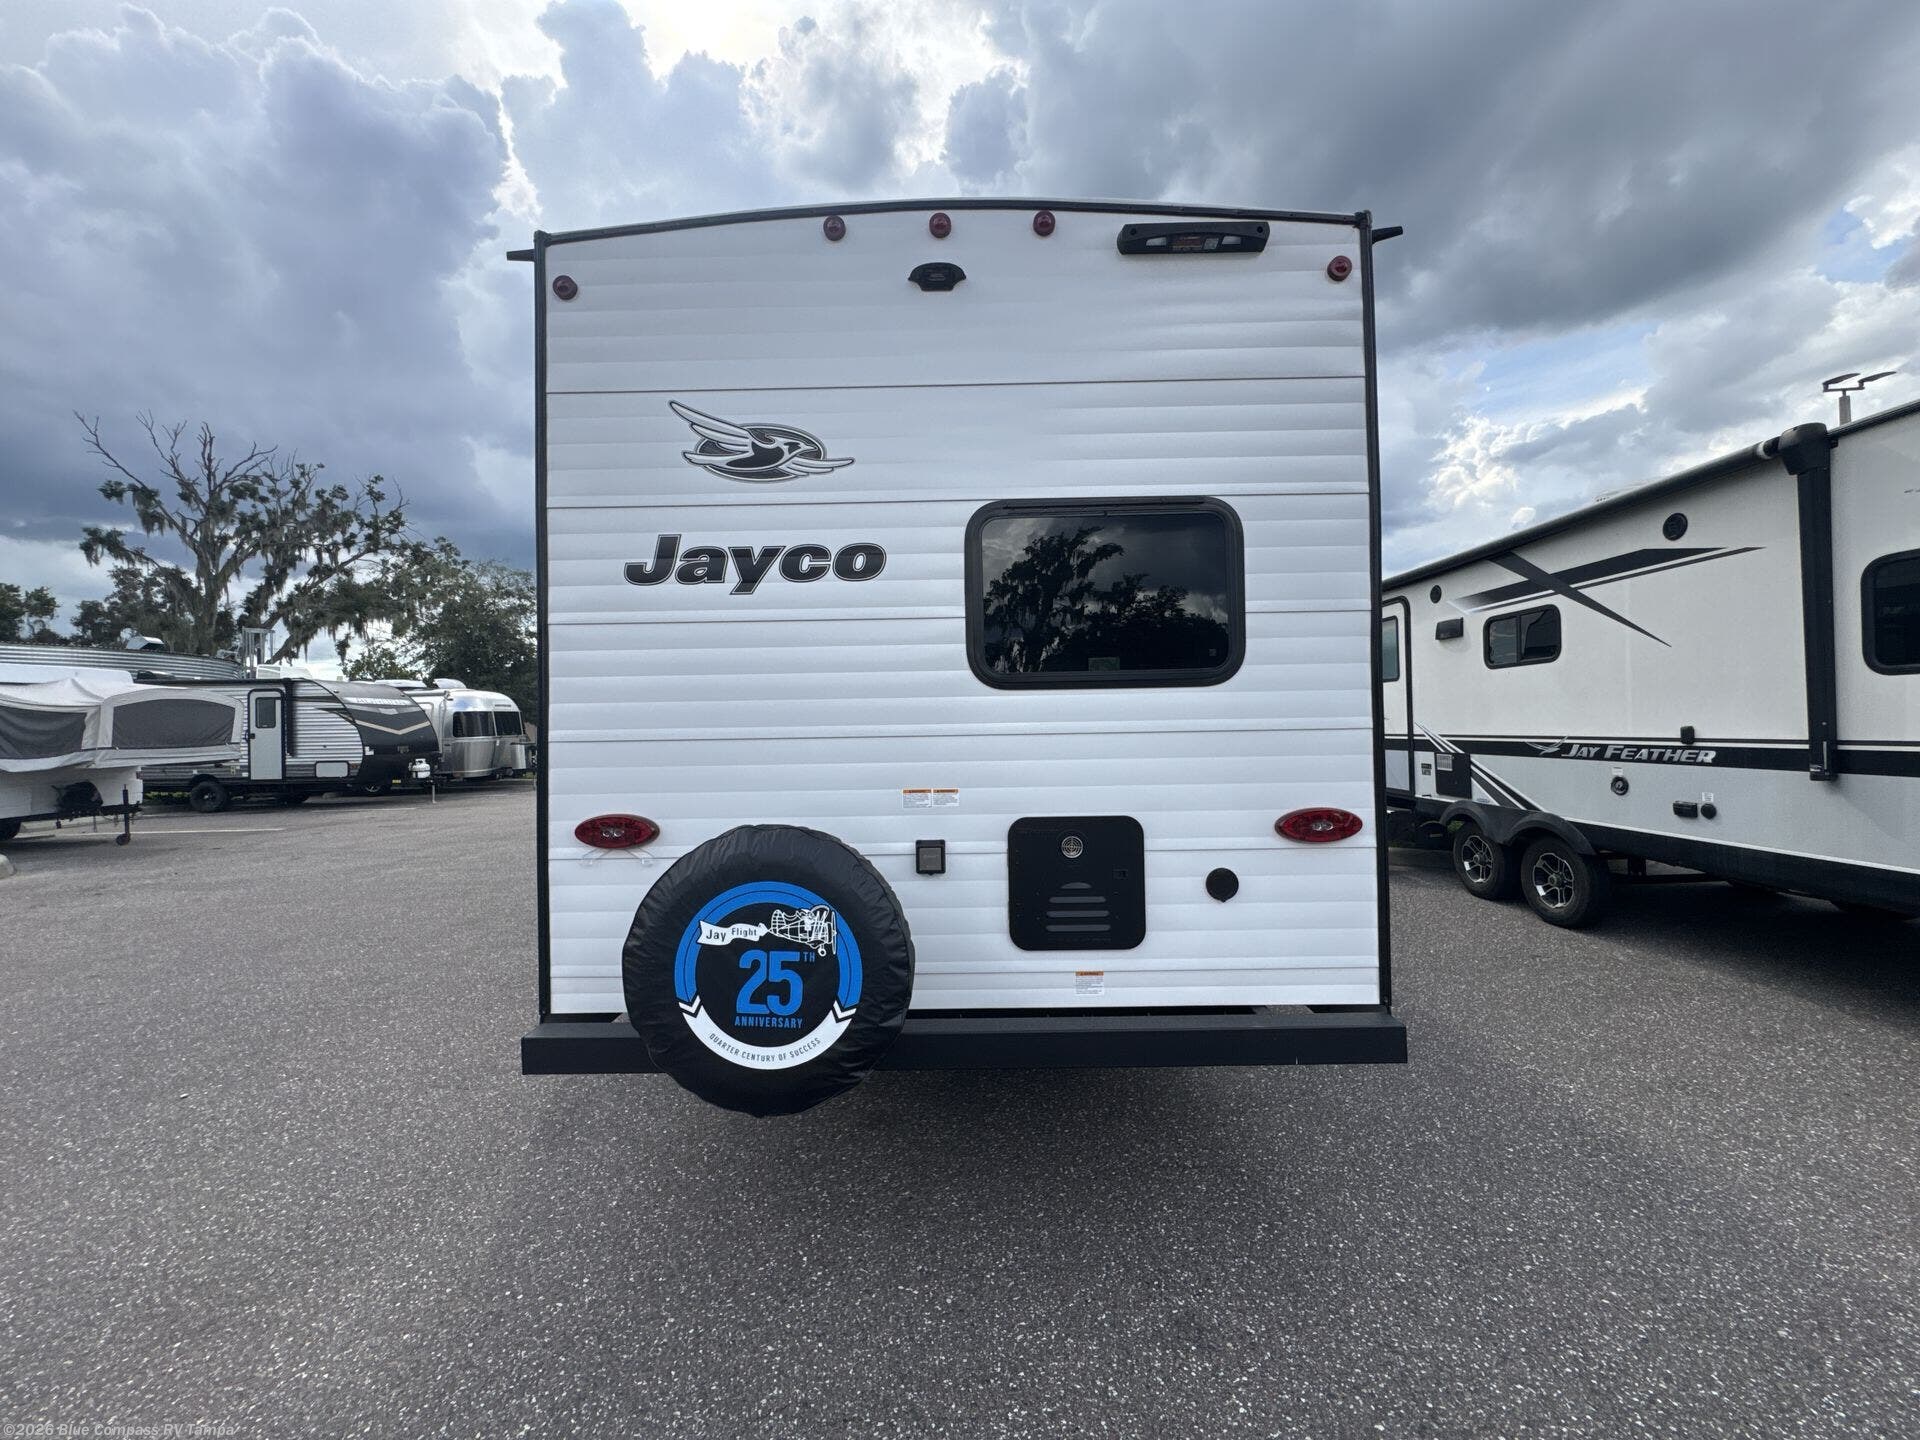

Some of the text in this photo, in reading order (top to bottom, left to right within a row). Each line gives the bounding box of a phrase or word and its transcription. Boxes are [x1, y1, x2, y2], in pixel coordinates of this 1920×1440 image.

[624, 534, 887, 595] Jayco
[1561, 743, 1717, 764] JAY FEATHER
[706, 927, 757, 943] Jay Flight
[734, 1016, 803, 1029] ANNIVERSARY
[709, 1033, 821, 1062] QUARTER CENTURY OF SUCCESS
